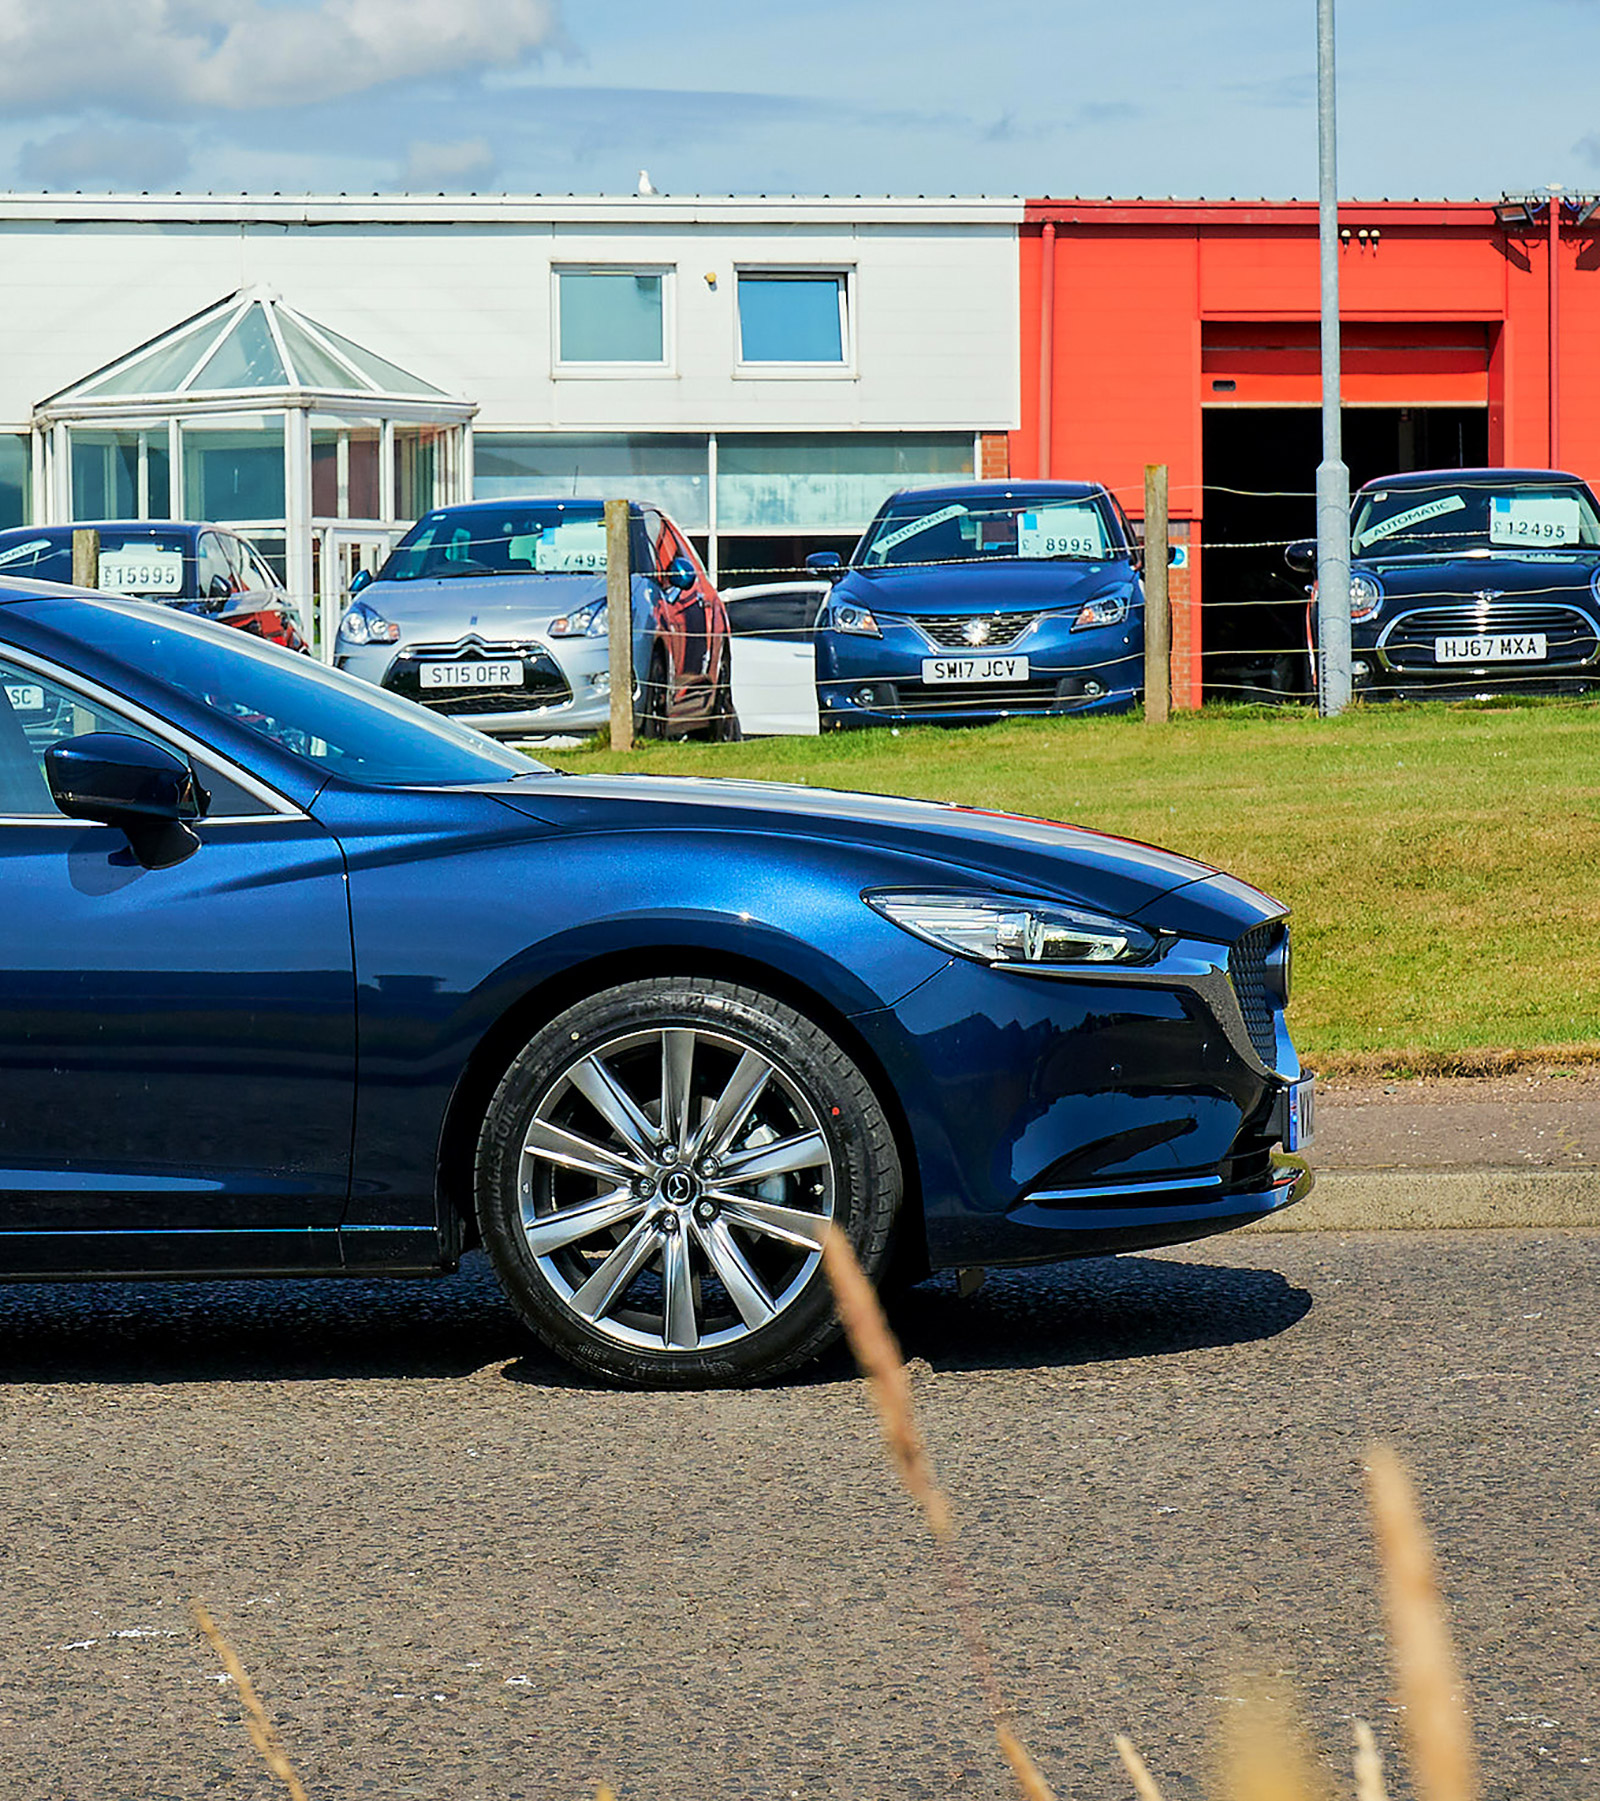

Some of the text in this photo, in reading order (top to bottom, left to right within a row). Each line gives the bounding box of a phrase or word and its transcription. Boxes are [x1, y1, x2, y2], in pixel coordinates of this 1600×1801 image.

[1373, 502, 1450, 536] AUTOMATIC
[1045, 538, 1093, 551] 8995
[1444, 638, 1537, 658] HJ67 MXA
[432, 665, 510, 683] ST15 OFR
[934, 660, 1016, 679] SW17 JCV
